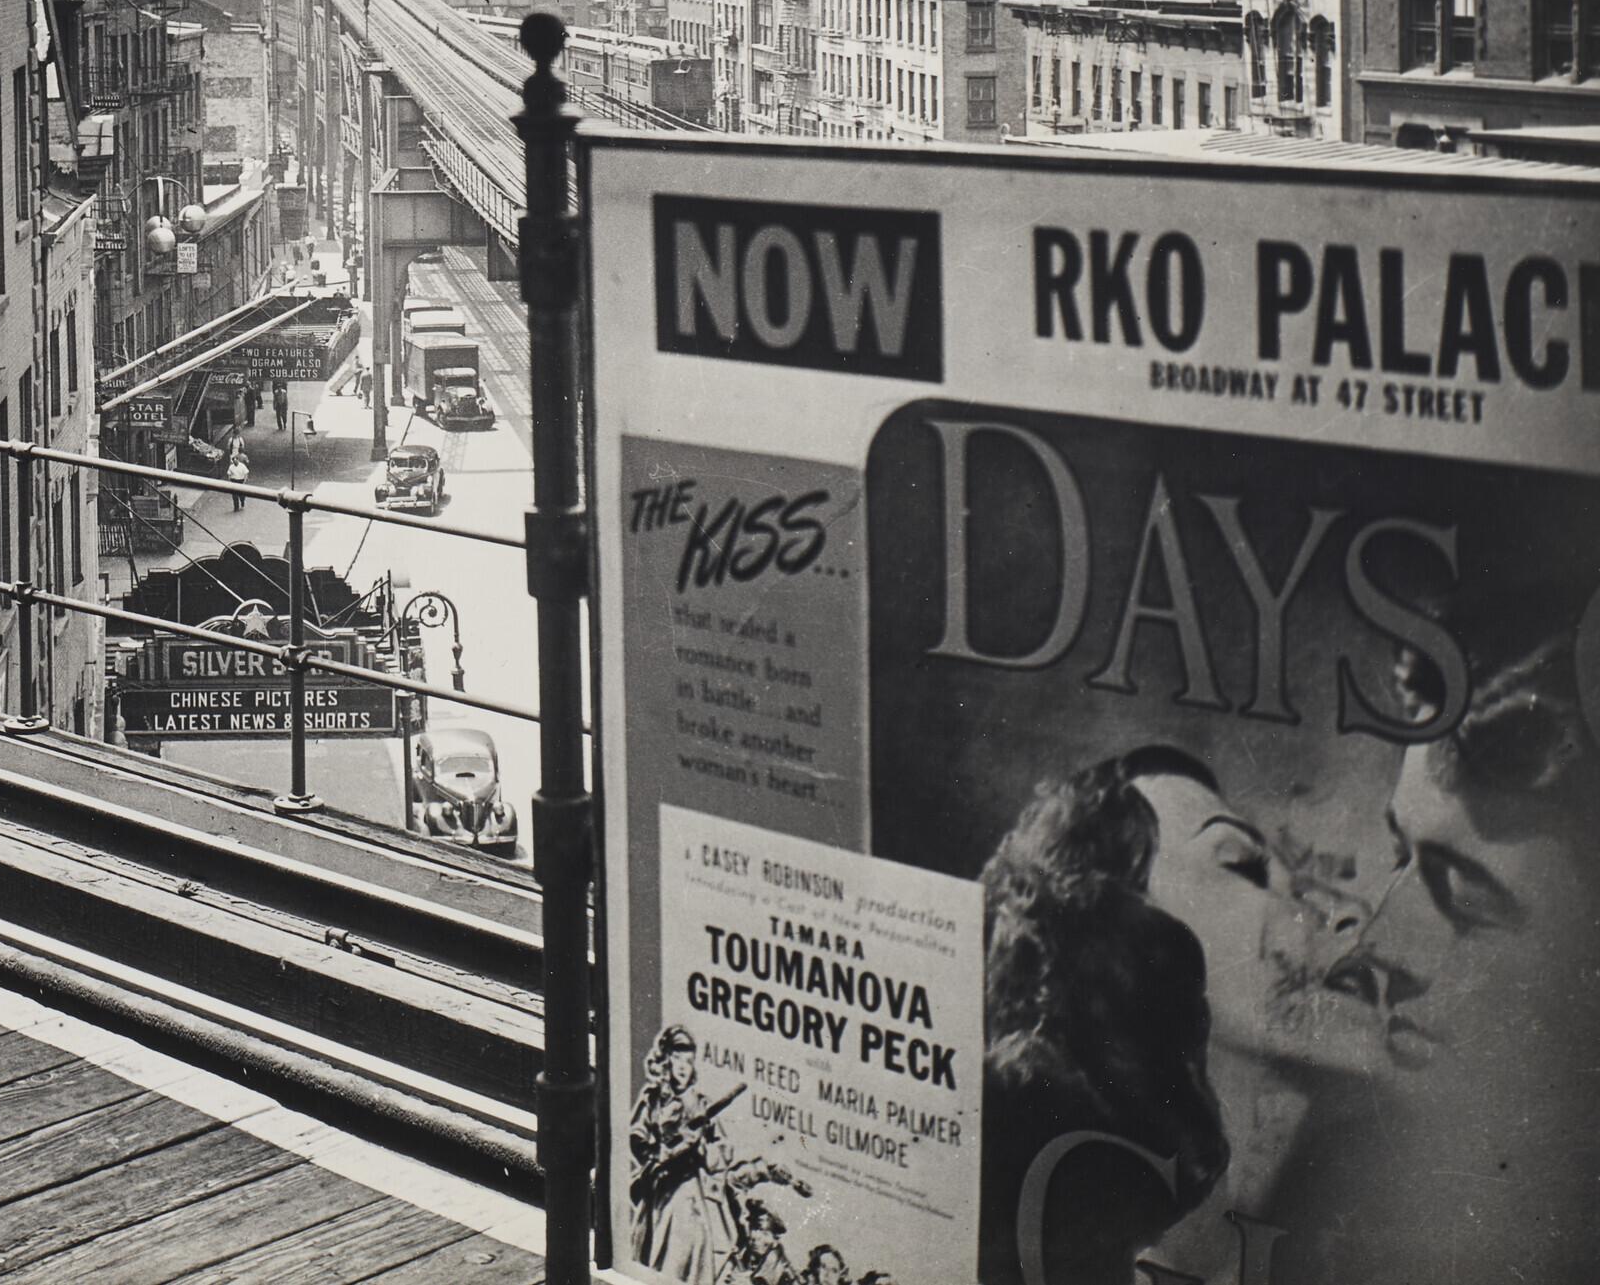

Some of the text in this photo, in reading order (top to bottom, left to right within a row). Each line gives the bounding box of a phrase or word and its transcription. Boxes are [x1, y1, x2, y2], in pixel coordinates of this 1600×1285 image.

[674, 221, 918, 356] NOW
[1033, 225, 1205, 353] RKO
[241, 348, 315, 357] TWO FEATURES
[269, 368, 319, 378] SUBJECTS
[296, 358, 321, 368] ALSO
[129, 403, 164, 412] STAR
[1149, 360, 1486, 424] BROADWAY AT 47 STREET
[130, 412, 168, 421] OTEL
[630, 479, 697, 534] THE
[923, 418, 1471, 745] DAYS
[674, 603, 796, 648] that sealed a
[183, 650, 266, 677] SILVER
[676, 646, 812, 690] romance born
[154, 712, 371, 731] LATEST NEWS & SHORTS
[170, 690, 338, 708] CHINESE PICTRES
[677, 678, 695, 700] in
[785, 703, 822, 728] and
[677, 709, 817, 763] broke another
[678, 753, 760, 787] woman's
[702, 844, 750, 877] CASEY
[763, 860, 845, 902] ROBINSON
[855, 896, 957, 934] production
[769, 915, 865, 960] TAMARA
[704, 924, 934, 1030] TOUMANOVA
[687, 972, 957, 1091] GREGORY PECK
[702, 1042, 962, 1148] ALAN REED MARIA PALMER
[752, 1094, 910, 1169] LOWELL GILMORE
